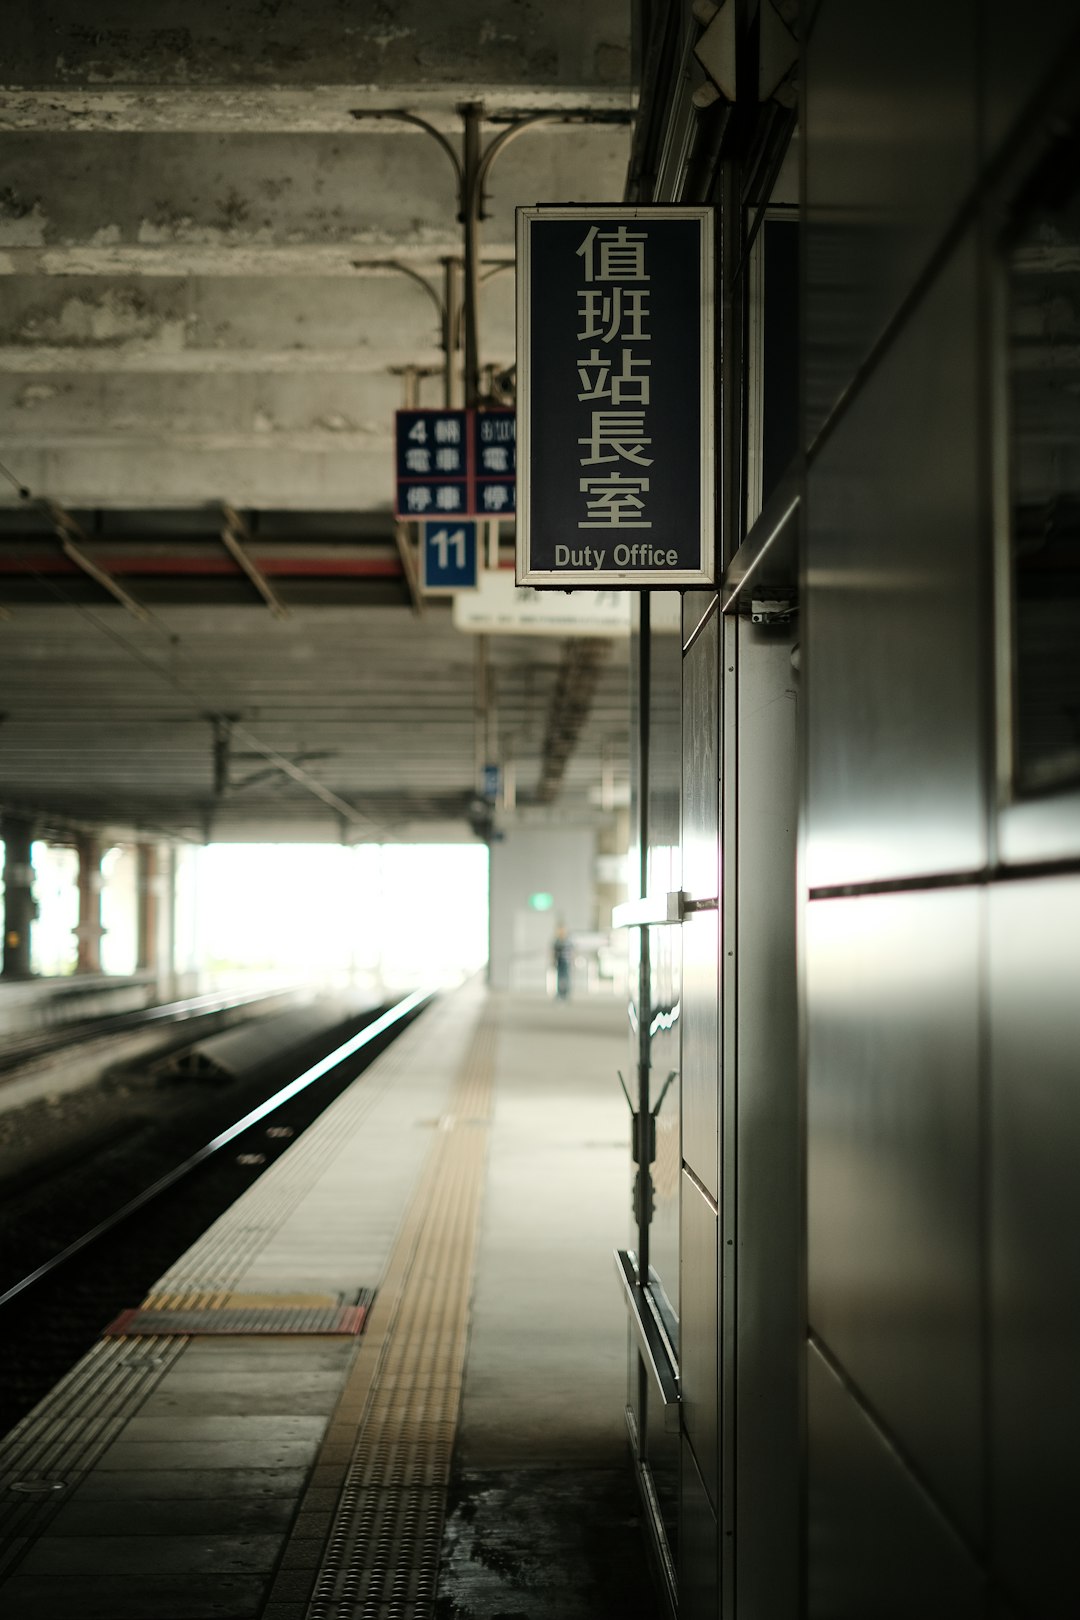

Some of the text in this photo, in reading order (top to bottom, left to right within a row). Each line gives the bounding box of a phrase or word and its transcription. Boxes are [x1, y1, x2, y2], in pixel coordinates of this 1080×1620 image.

[575, 225, 654, 530] 值班站長室
[429, 529, 466, 570] 11
[555, 543, 679, 570] Duty Office
